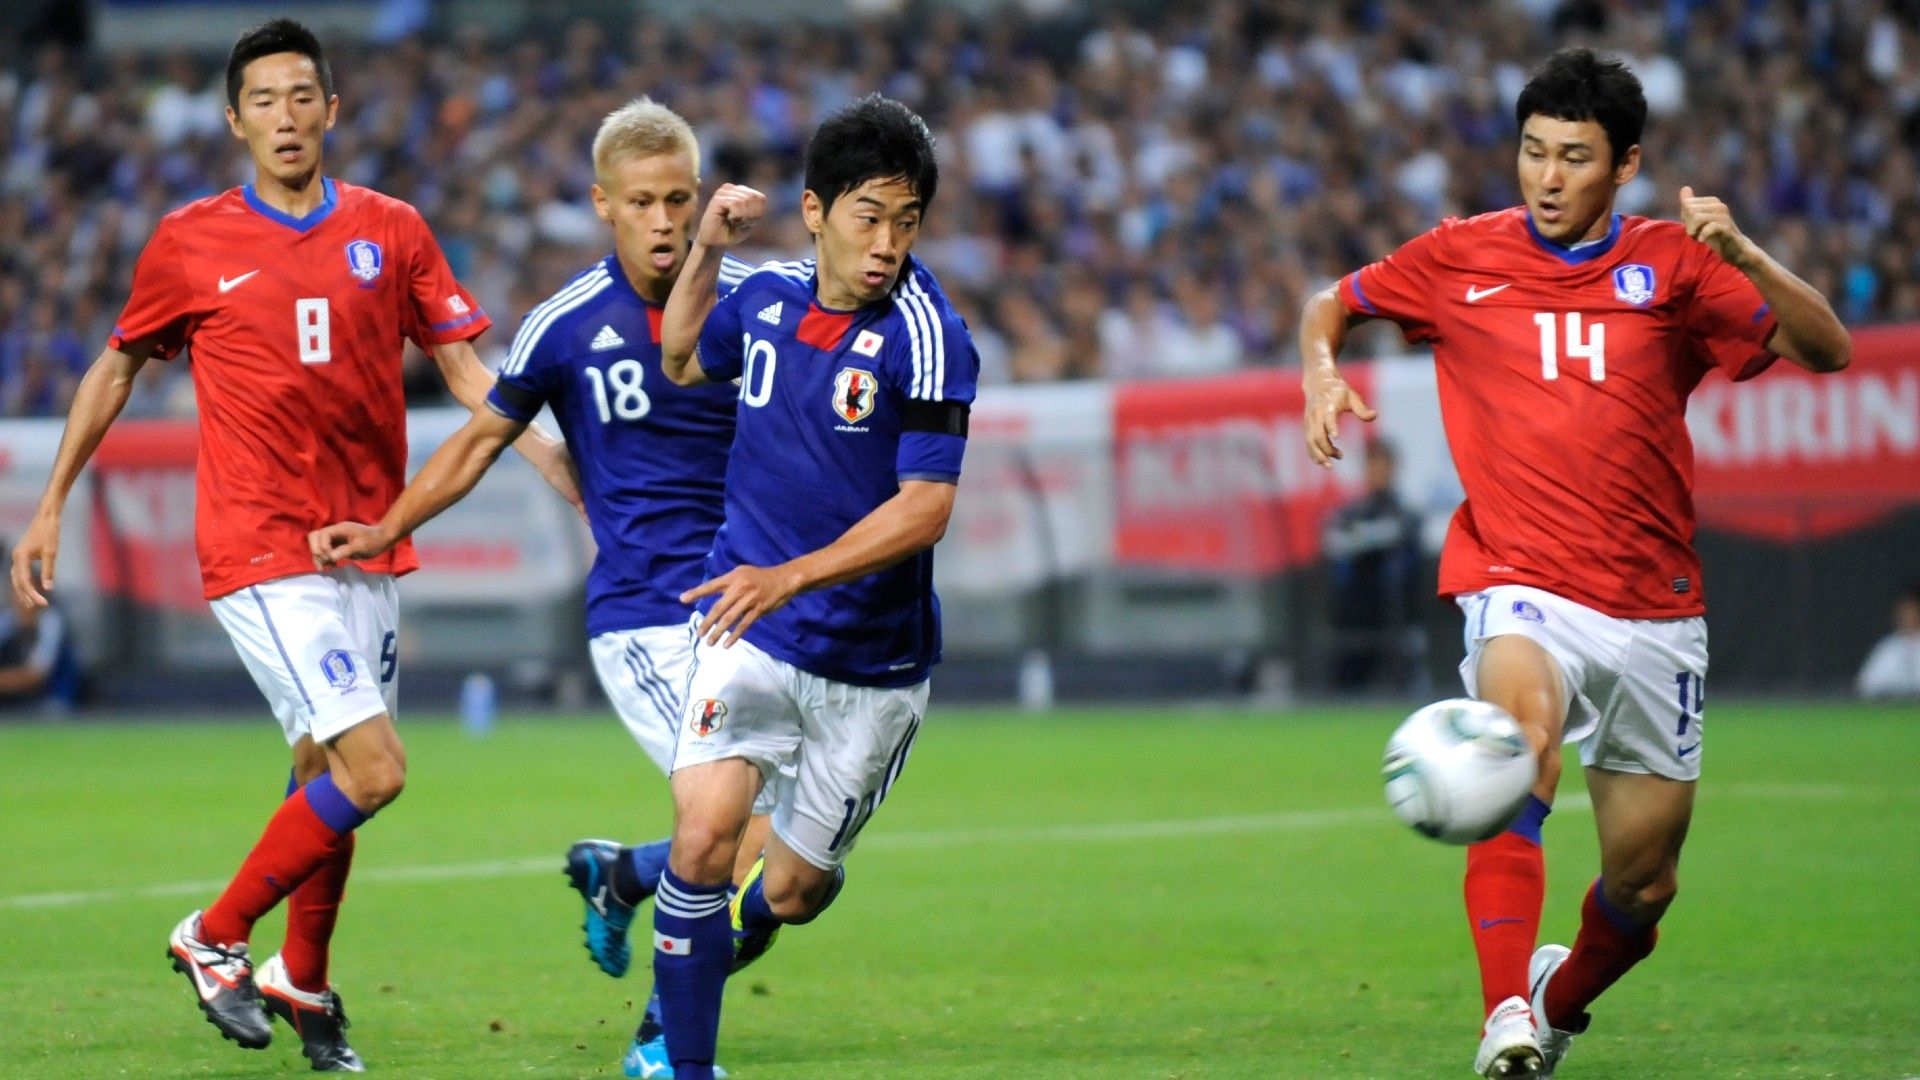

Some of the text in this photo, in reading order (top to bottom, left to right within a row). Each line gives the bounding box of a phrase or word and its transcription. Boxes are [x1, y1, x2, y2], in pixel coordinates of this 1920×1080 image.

[296, 297, 331, 363] 8
[1533, 311, 1606, 382] 14
[584, 359, 651, 423] 18
[833, 425, 870, 433] JAPAN
